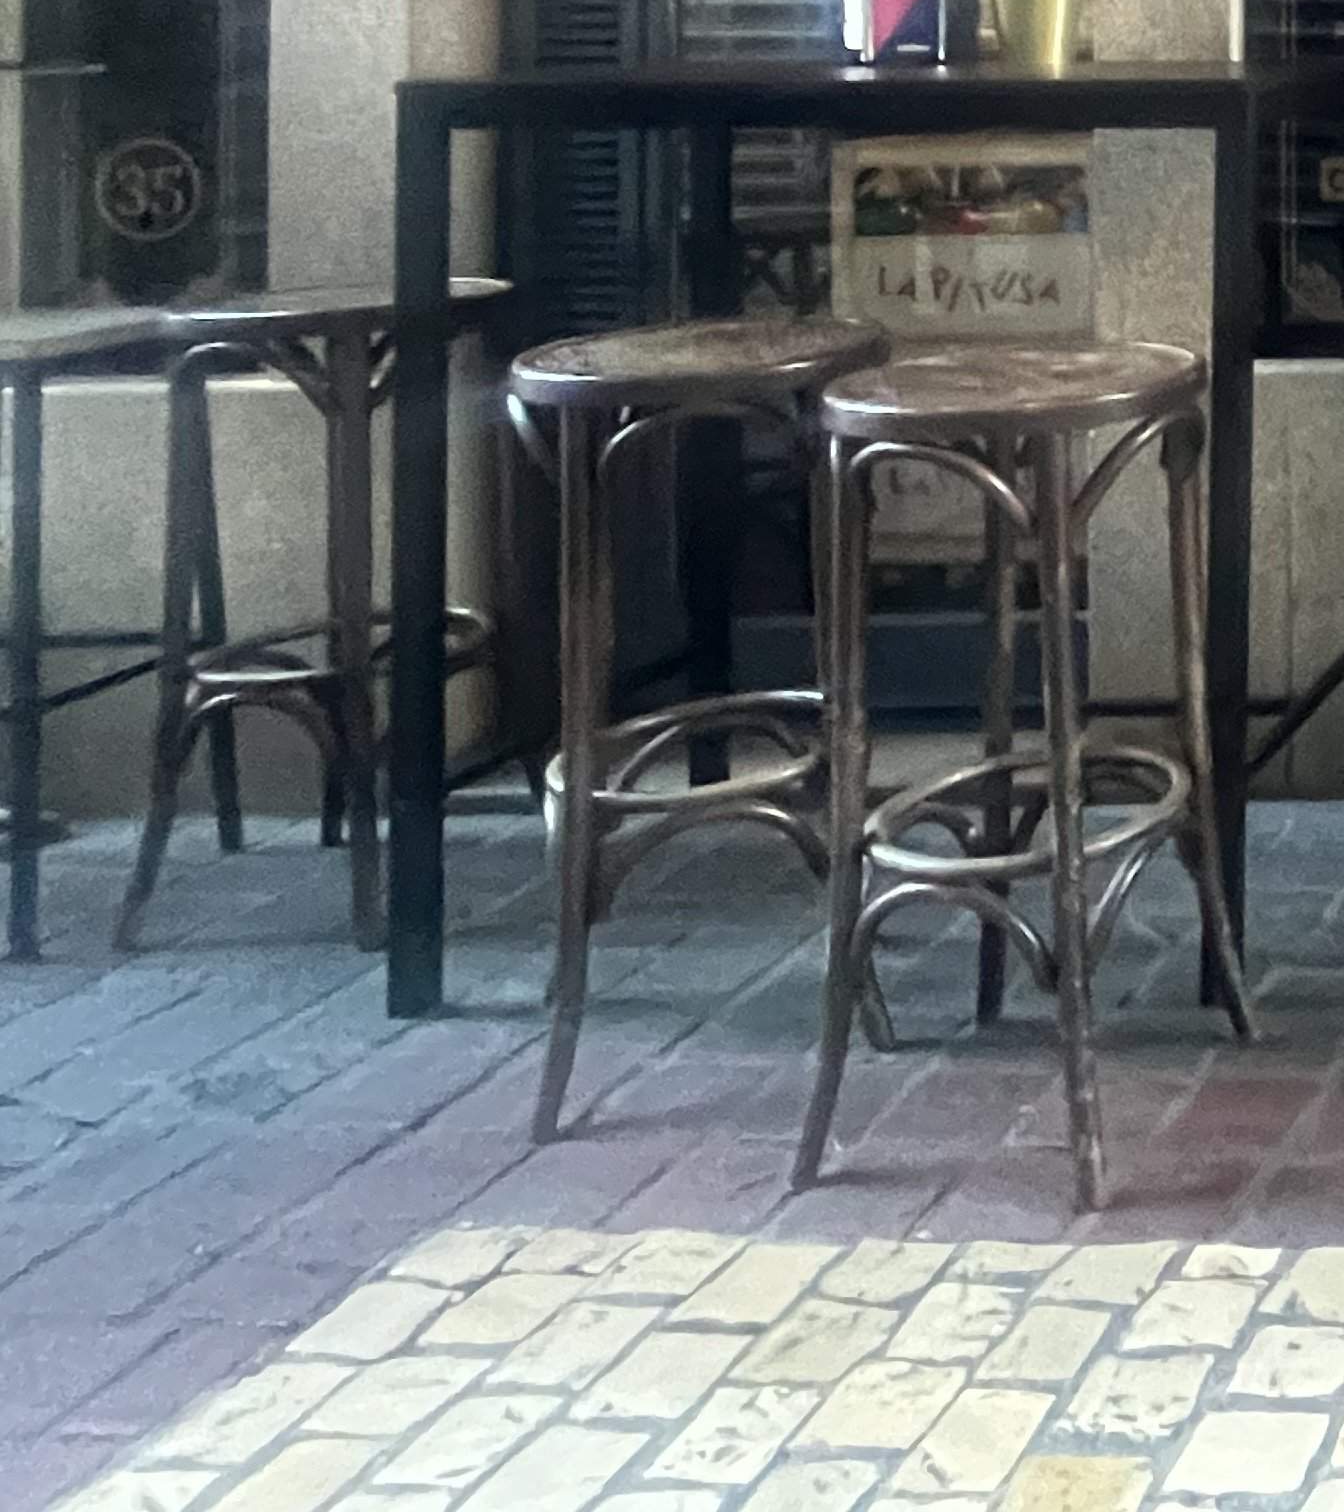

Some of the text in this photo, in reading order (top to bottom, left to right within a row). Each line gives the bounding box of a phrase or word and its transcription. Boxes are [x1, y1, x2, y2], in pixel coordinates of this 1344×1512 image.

[115, 165, 185, 216] 35
[877, 265, 1061, 312] LA PITUSA
